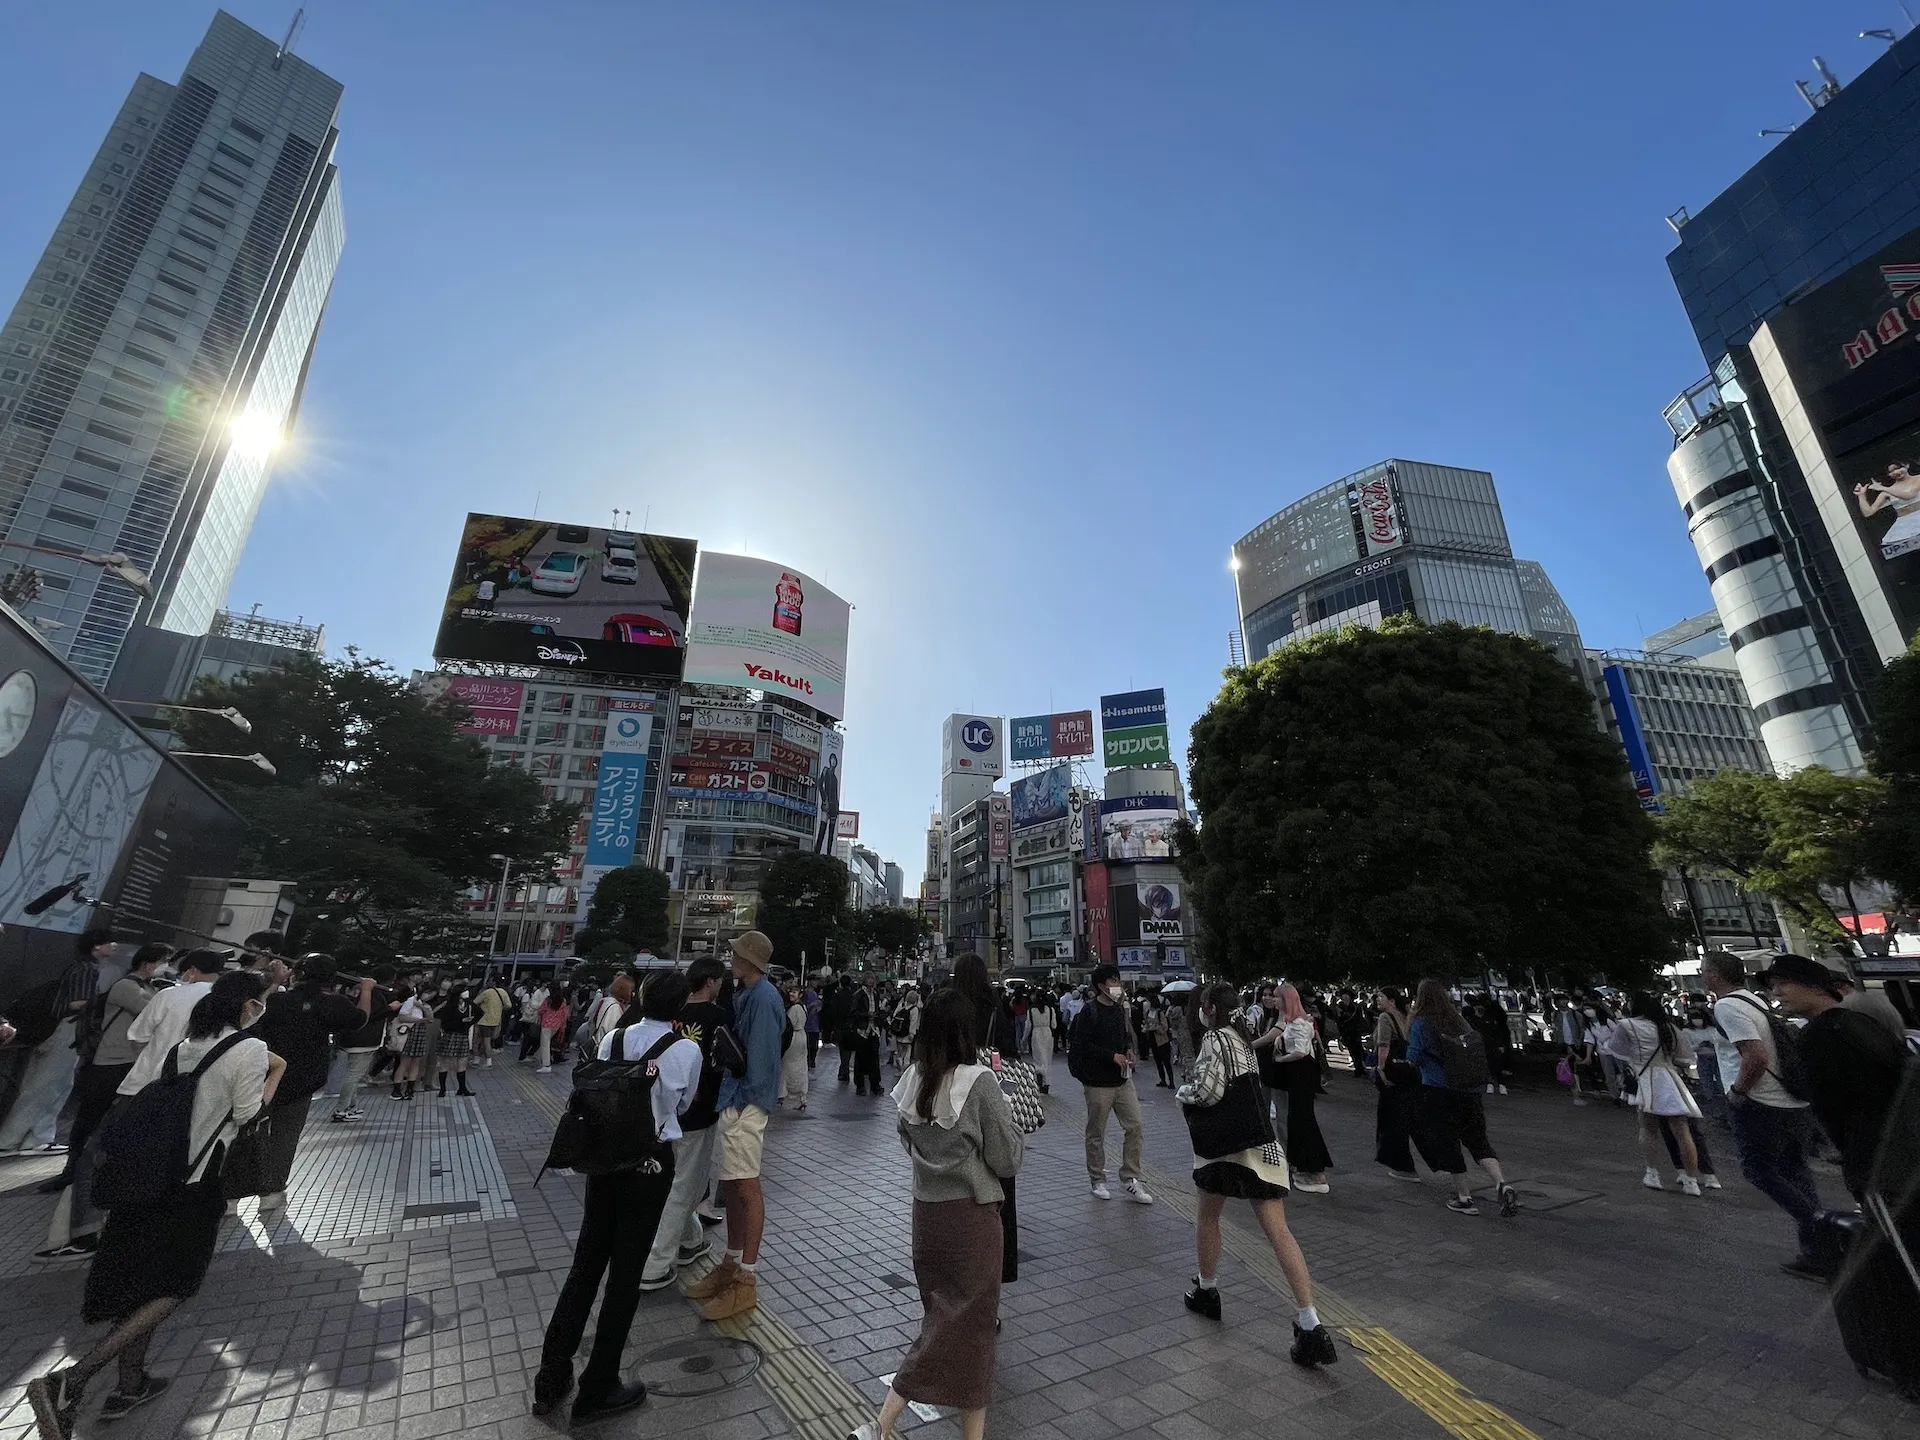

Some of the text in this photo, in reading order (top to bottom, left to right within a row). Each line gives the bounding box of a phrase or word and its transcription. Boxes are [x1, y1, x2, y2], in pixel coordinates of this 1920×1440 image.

[537, 643, 587, 665] Disney+
[744, 662, 814, 695] Yakult
[469, 684, 519, 695] 品川スキン
[468, 694, 512, 705] クリニック
[680, 713, 692, 721] 9F
[1102, 703, 1166, 718] Hisamitsu
[963, 726, 994, 746] UC
[609, 739, 644, 749] eyecity
[1106, 735, 1166, 756] サロンパス
[729, 761, 759, 771] ガスト
[983, 762, 999, 770] VISA
[671, 773, 686, 782] 7F
[707, 773, 745, 788] ガスト
[595, 766, 623, 848] アイシティ
[615, 767, 639, 848] コンタクトの
[1124, 797, 1149, 808] DHC
[1068, 787, 1084, 848] もんじゃ
[1142, 921, 1181, 934] DMM
